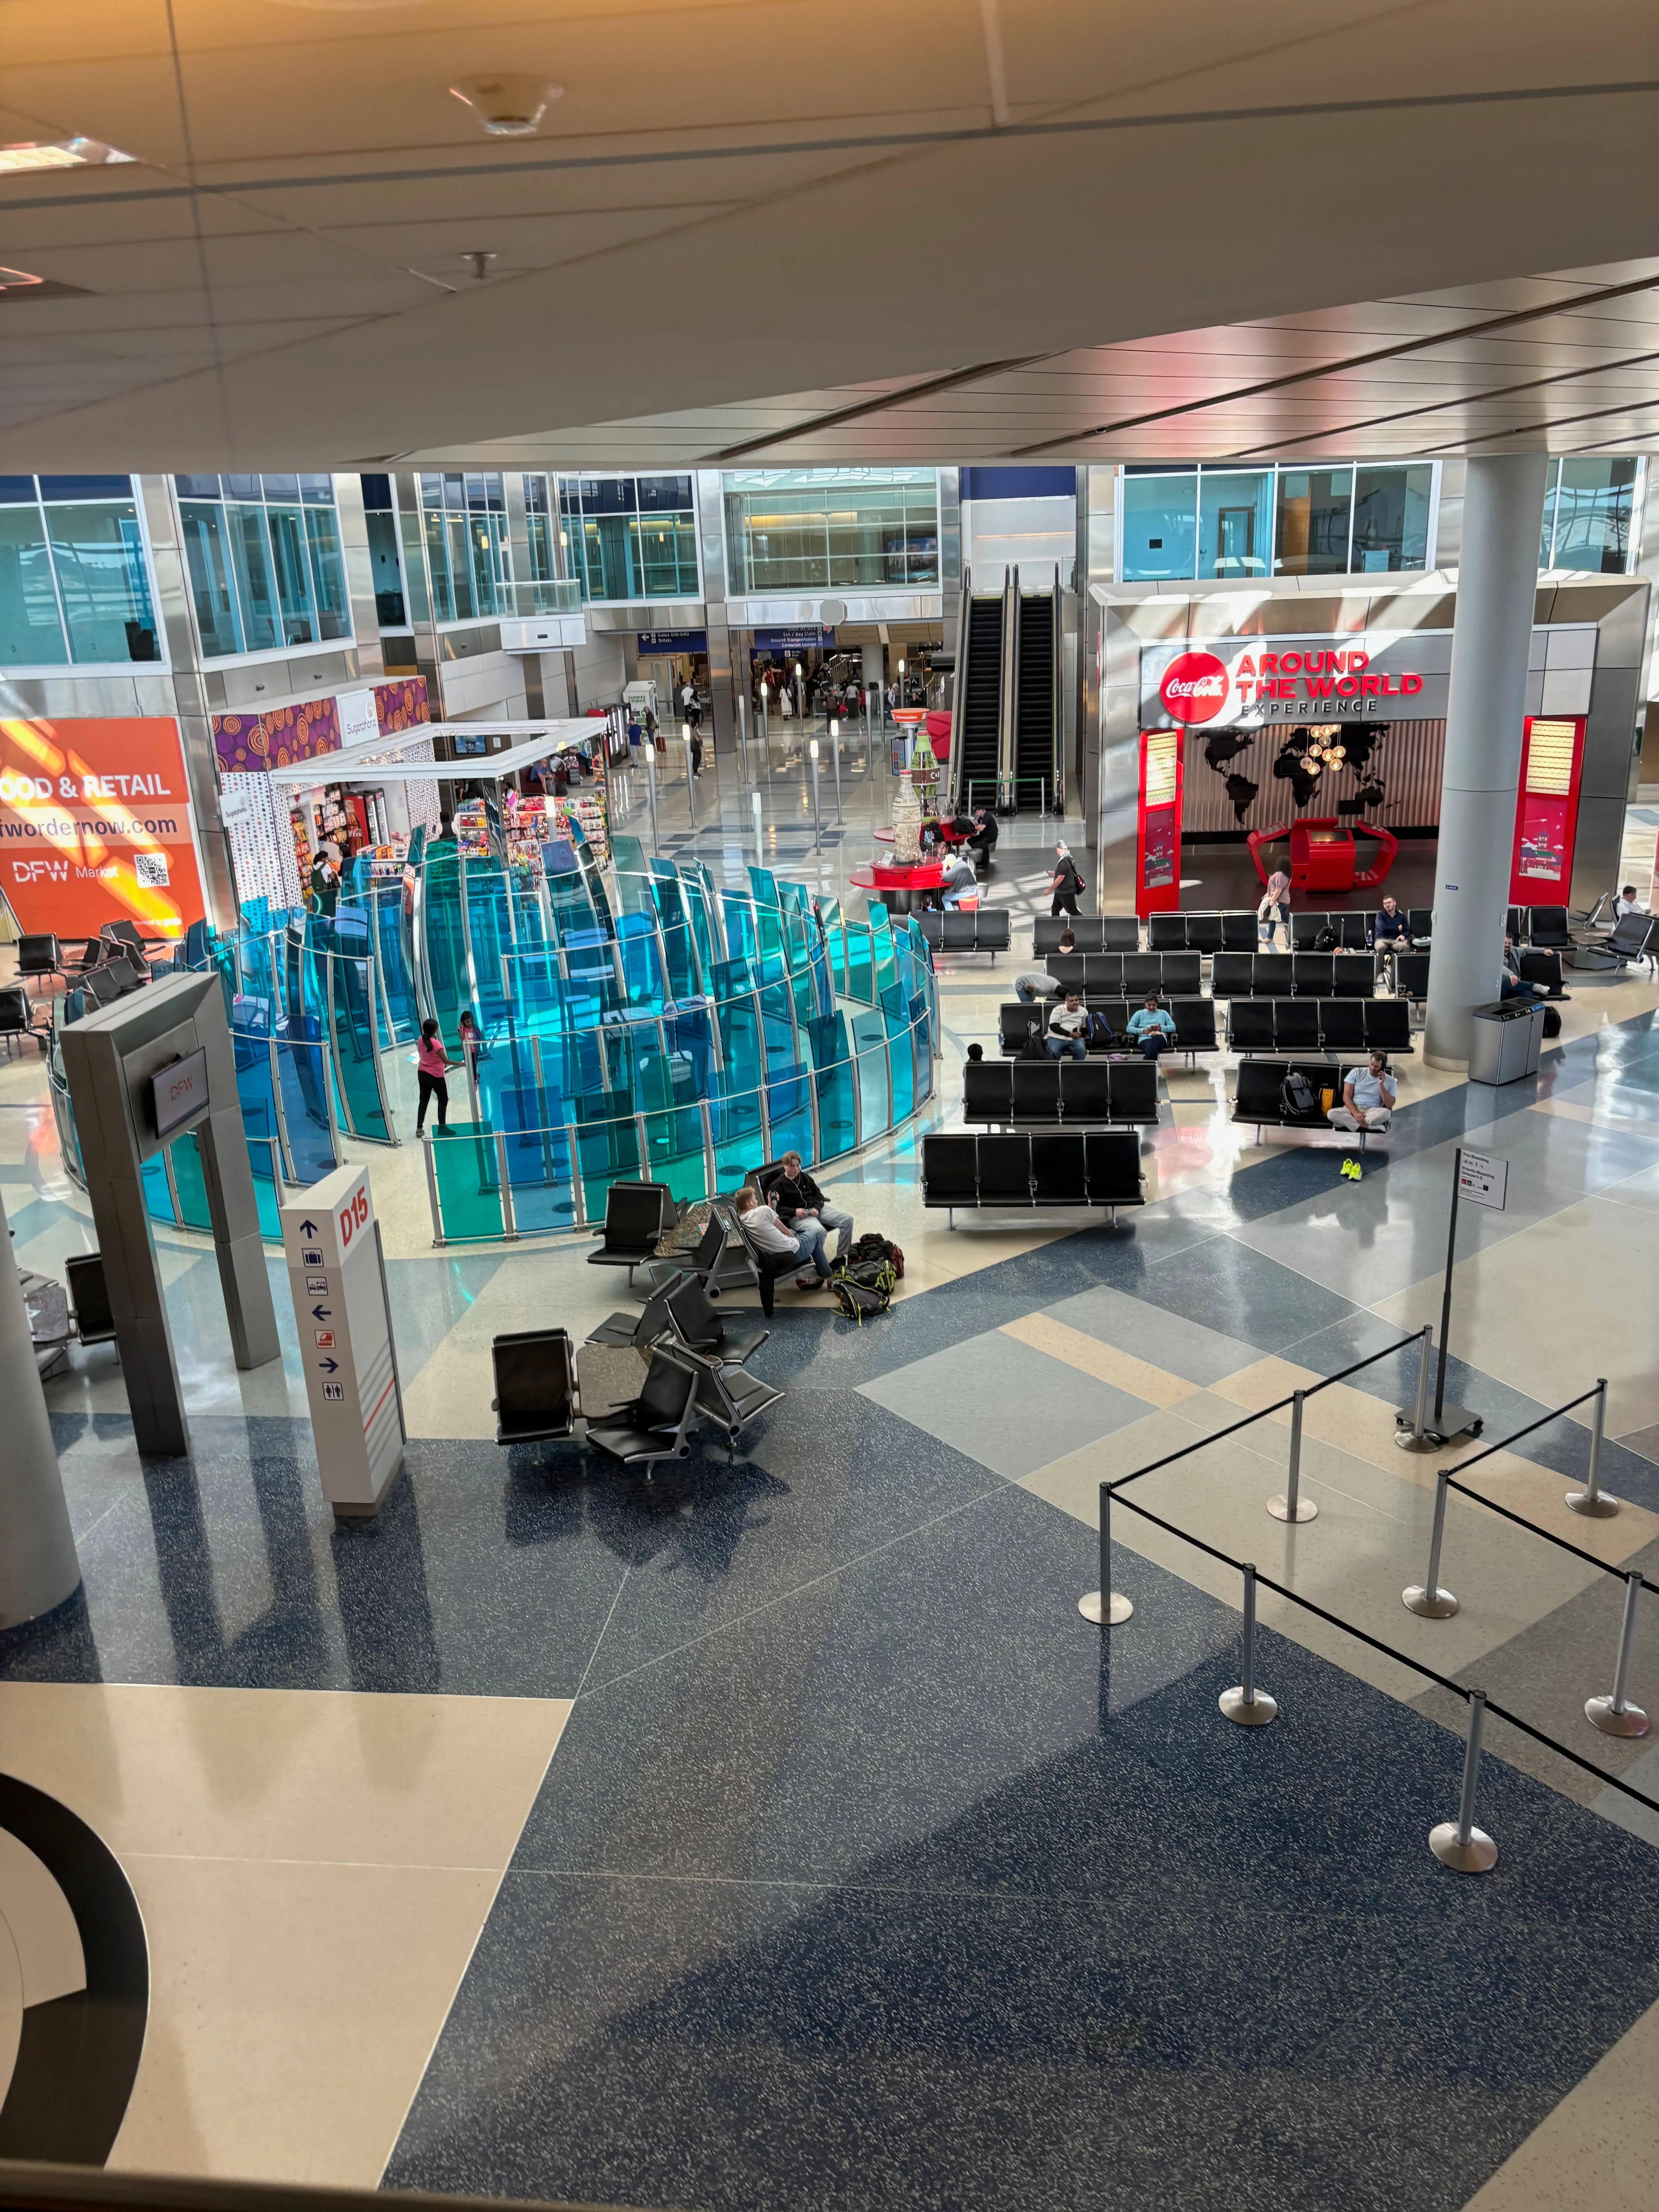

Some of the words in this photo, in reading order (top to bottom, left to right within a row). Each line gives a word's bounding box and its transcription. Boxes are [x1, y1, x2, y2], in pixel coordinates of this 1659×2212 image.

[1236, 650, 1369, 677] AROUND
[1166, 675, 1224, 698] Coca-Cola
[1236, 678, 1297, 703] THE
[1305, 672, 1423, 698] WORLD
[1241, 699, 1377, 717] EXPERIENCE
[0, 776, 53, 800] OOD
[59, 776, 79, 799] &
[82, 774, 171, 799] RETAIL
[12, 860, 69, 883] DFW
[76, 865, 119, 879] Market
[170, 1074, 193, 1101] DFW
[340, 1185, 368, 1248] D15
